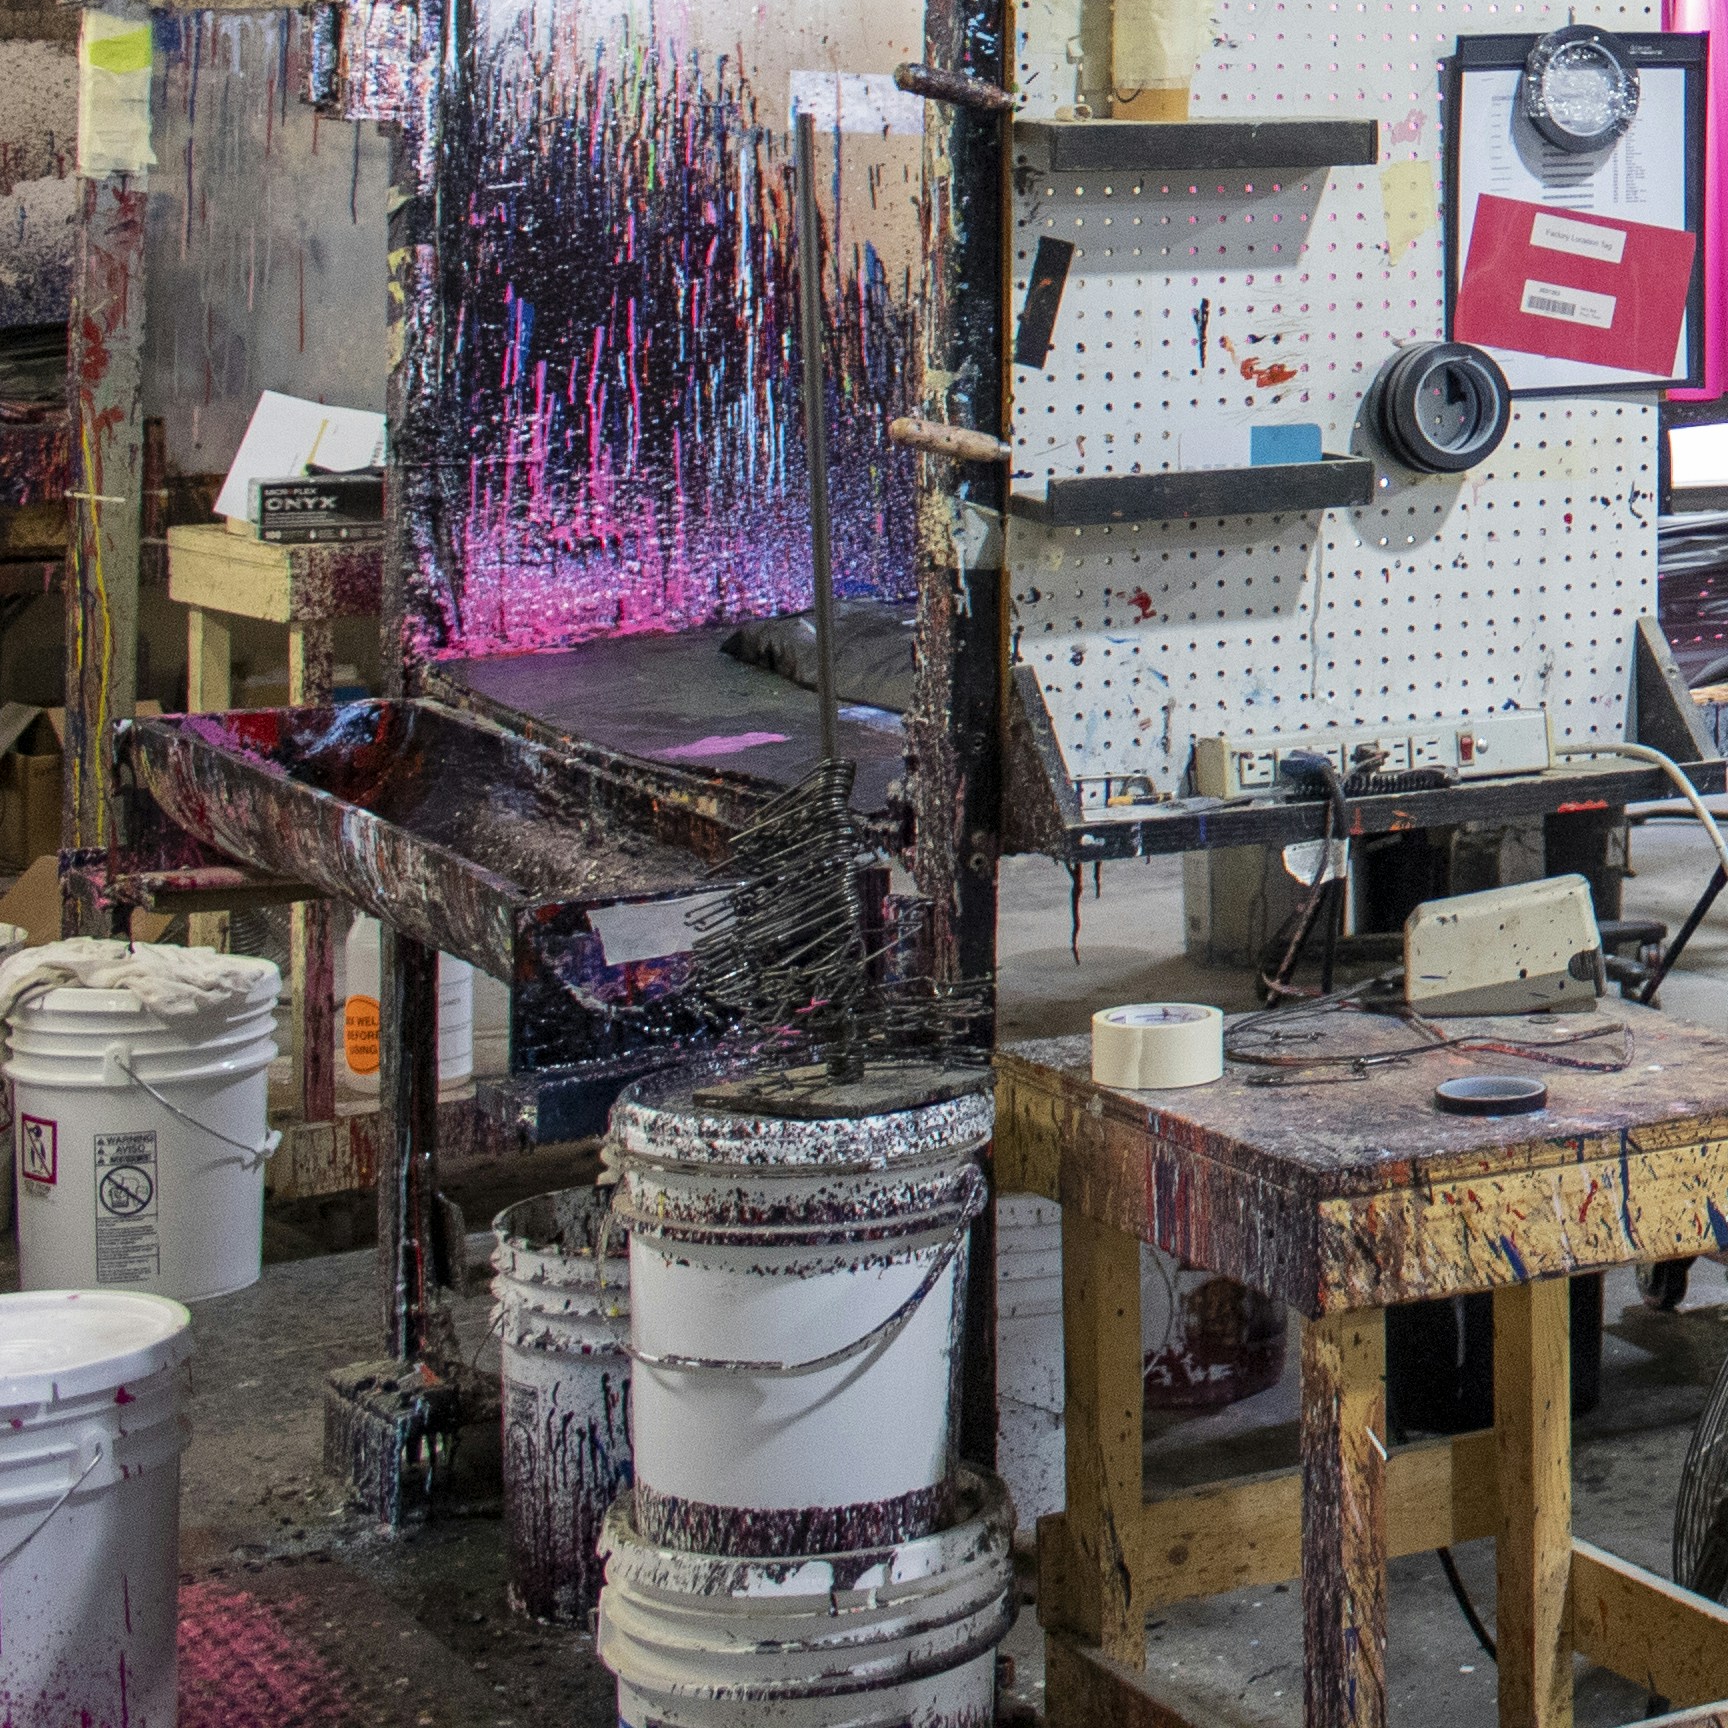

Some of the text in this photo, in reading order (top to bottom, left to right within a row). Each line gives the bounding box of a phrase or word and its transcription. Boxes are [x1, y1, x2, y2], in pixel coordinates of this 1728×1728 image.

[1545, 228, 1570, 242] Factory
[264, 496, 338, 511] ONYX
[357, 1016, 379, 1026] WEL
[106, 1135, 154, 1146] WARNING
[116, 1144, 146, 1154] AVISO
